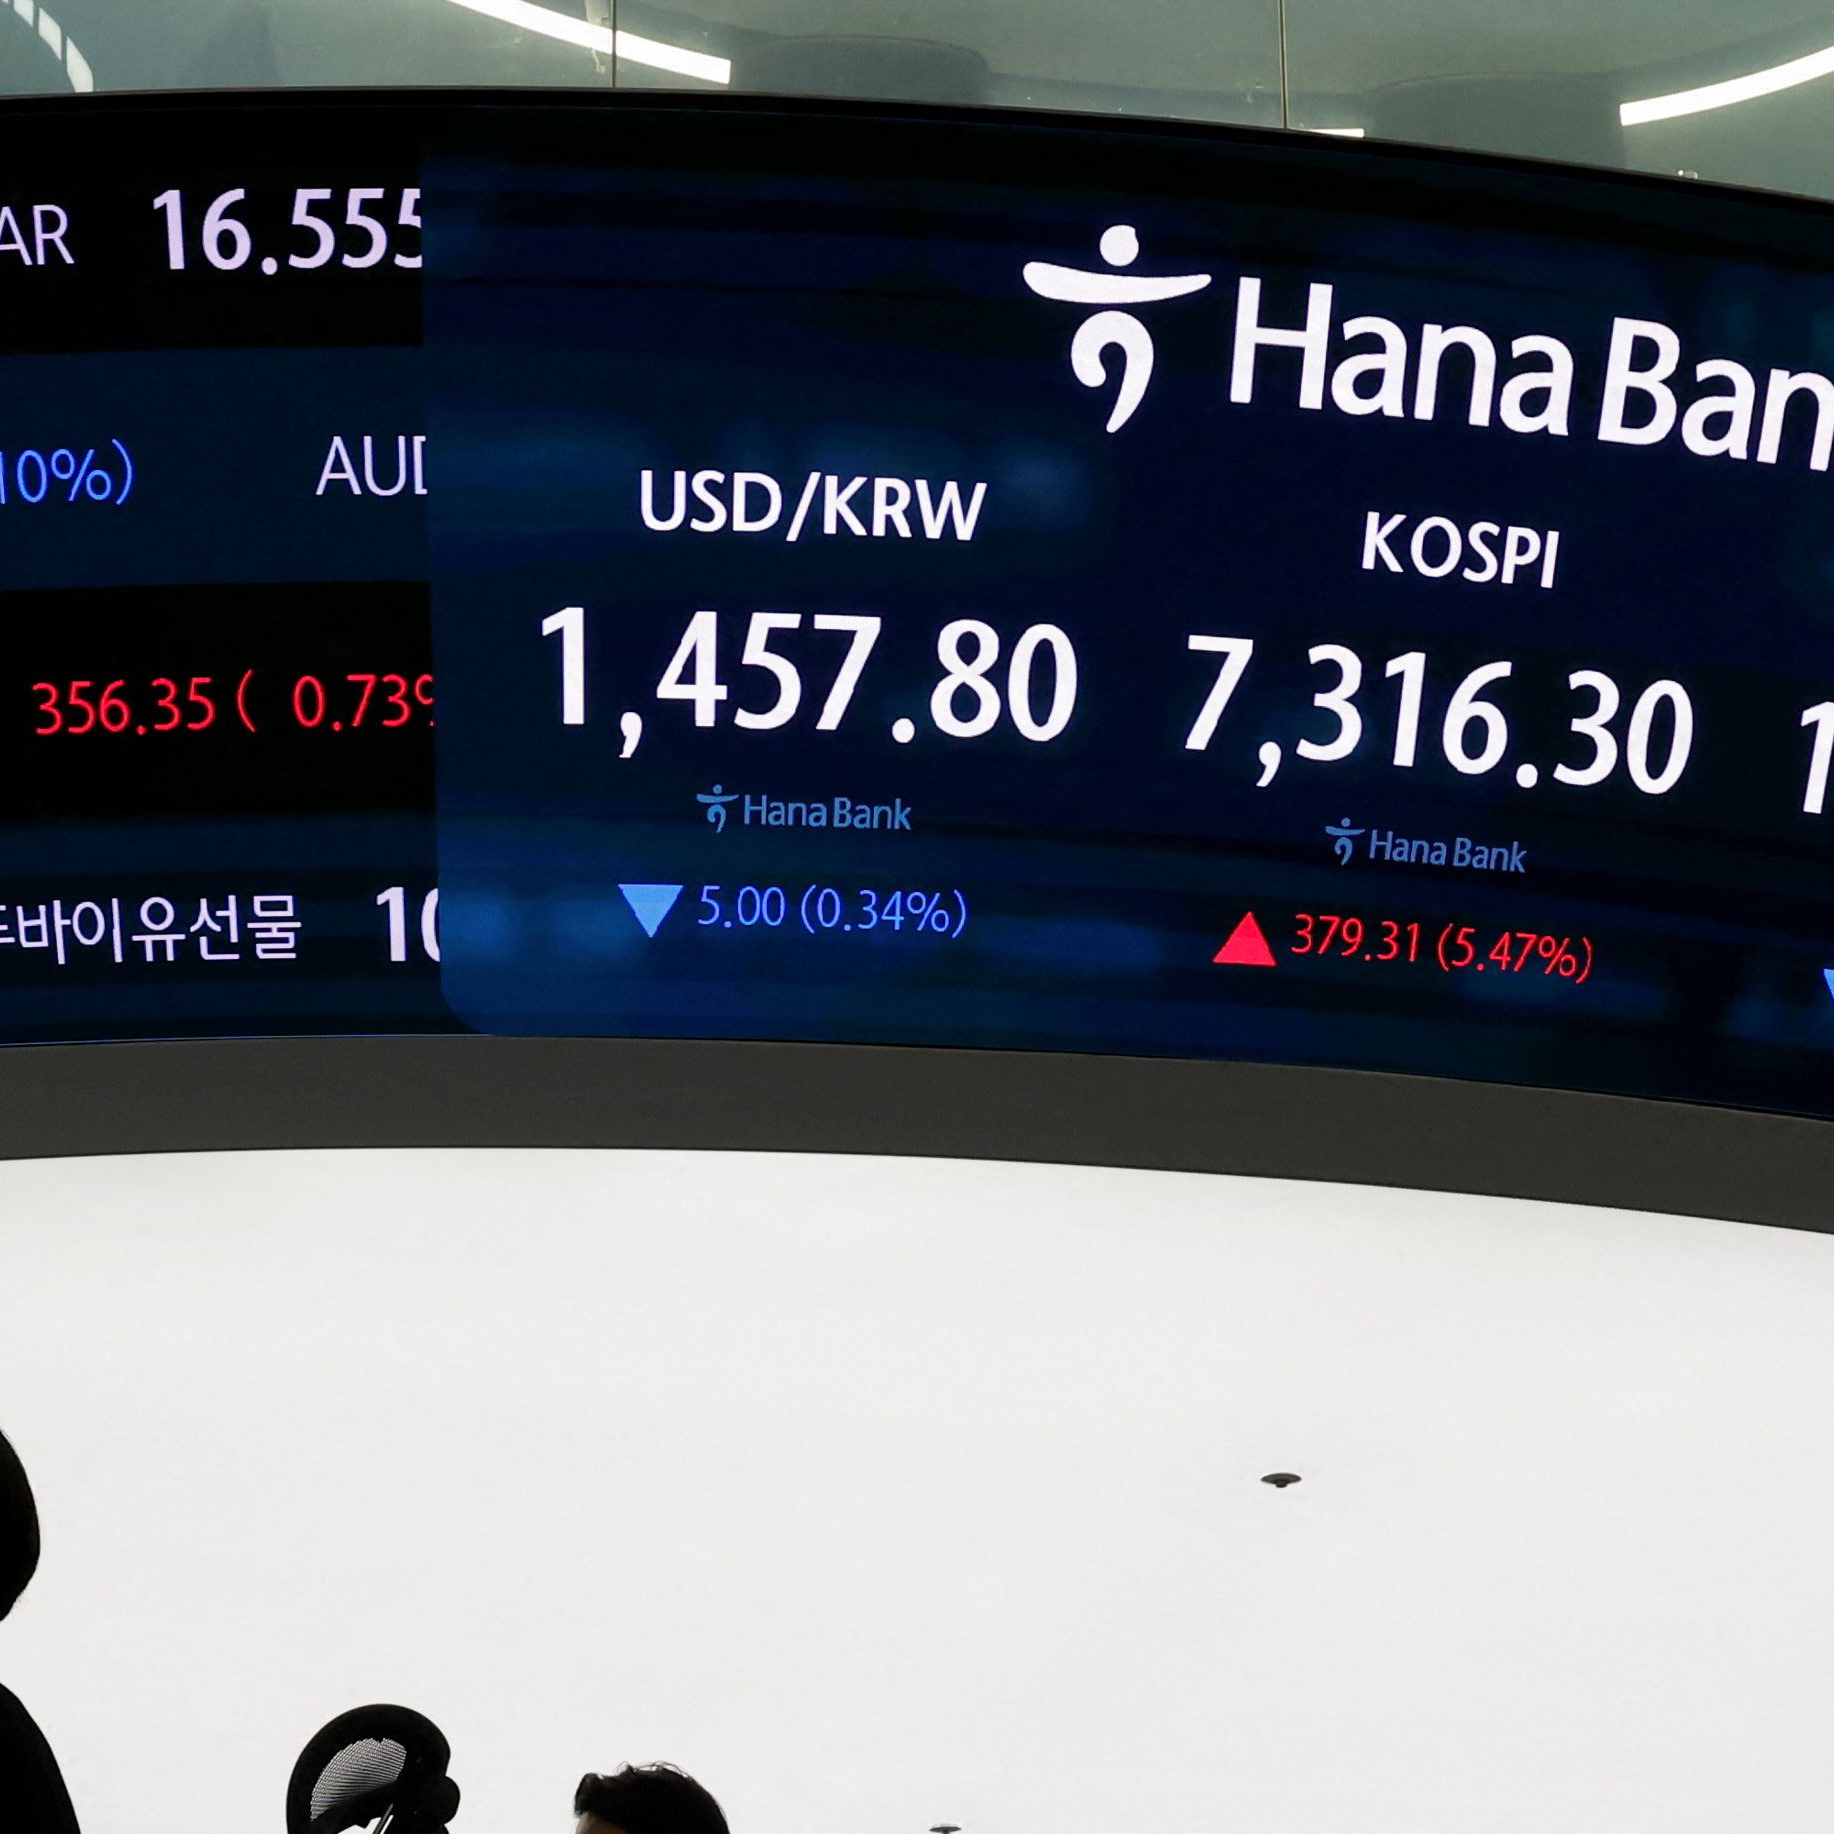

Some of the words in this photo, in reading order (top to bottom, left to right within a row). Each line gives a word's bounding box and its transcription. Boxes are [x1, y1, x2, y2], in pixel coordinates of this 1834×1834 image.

[1229, 276, 1574, 437] Hana
[640, 469, 988, 542] USD/KRW
[1361, 510, 1560, 589] KOSPI
[32, 676, 216, 736] 356.35
[541, 606, 1078, 759] 1,457.80
[1184, 634, 1694, 795] 7,316.30
[742, 793, 829, 828] Hana
[832, 796, 912, 831] Bank
[1368, 828, 1448, 866] Hana
[1452, 836, 1528, 874] Bank
[695, 884, 790, 929] 5.00
[798, 883, 969, 939] (0.34%)
[1291, 913, 1420, 962] 379.31
[1437, 923, 1592, 984] (5.47%)
